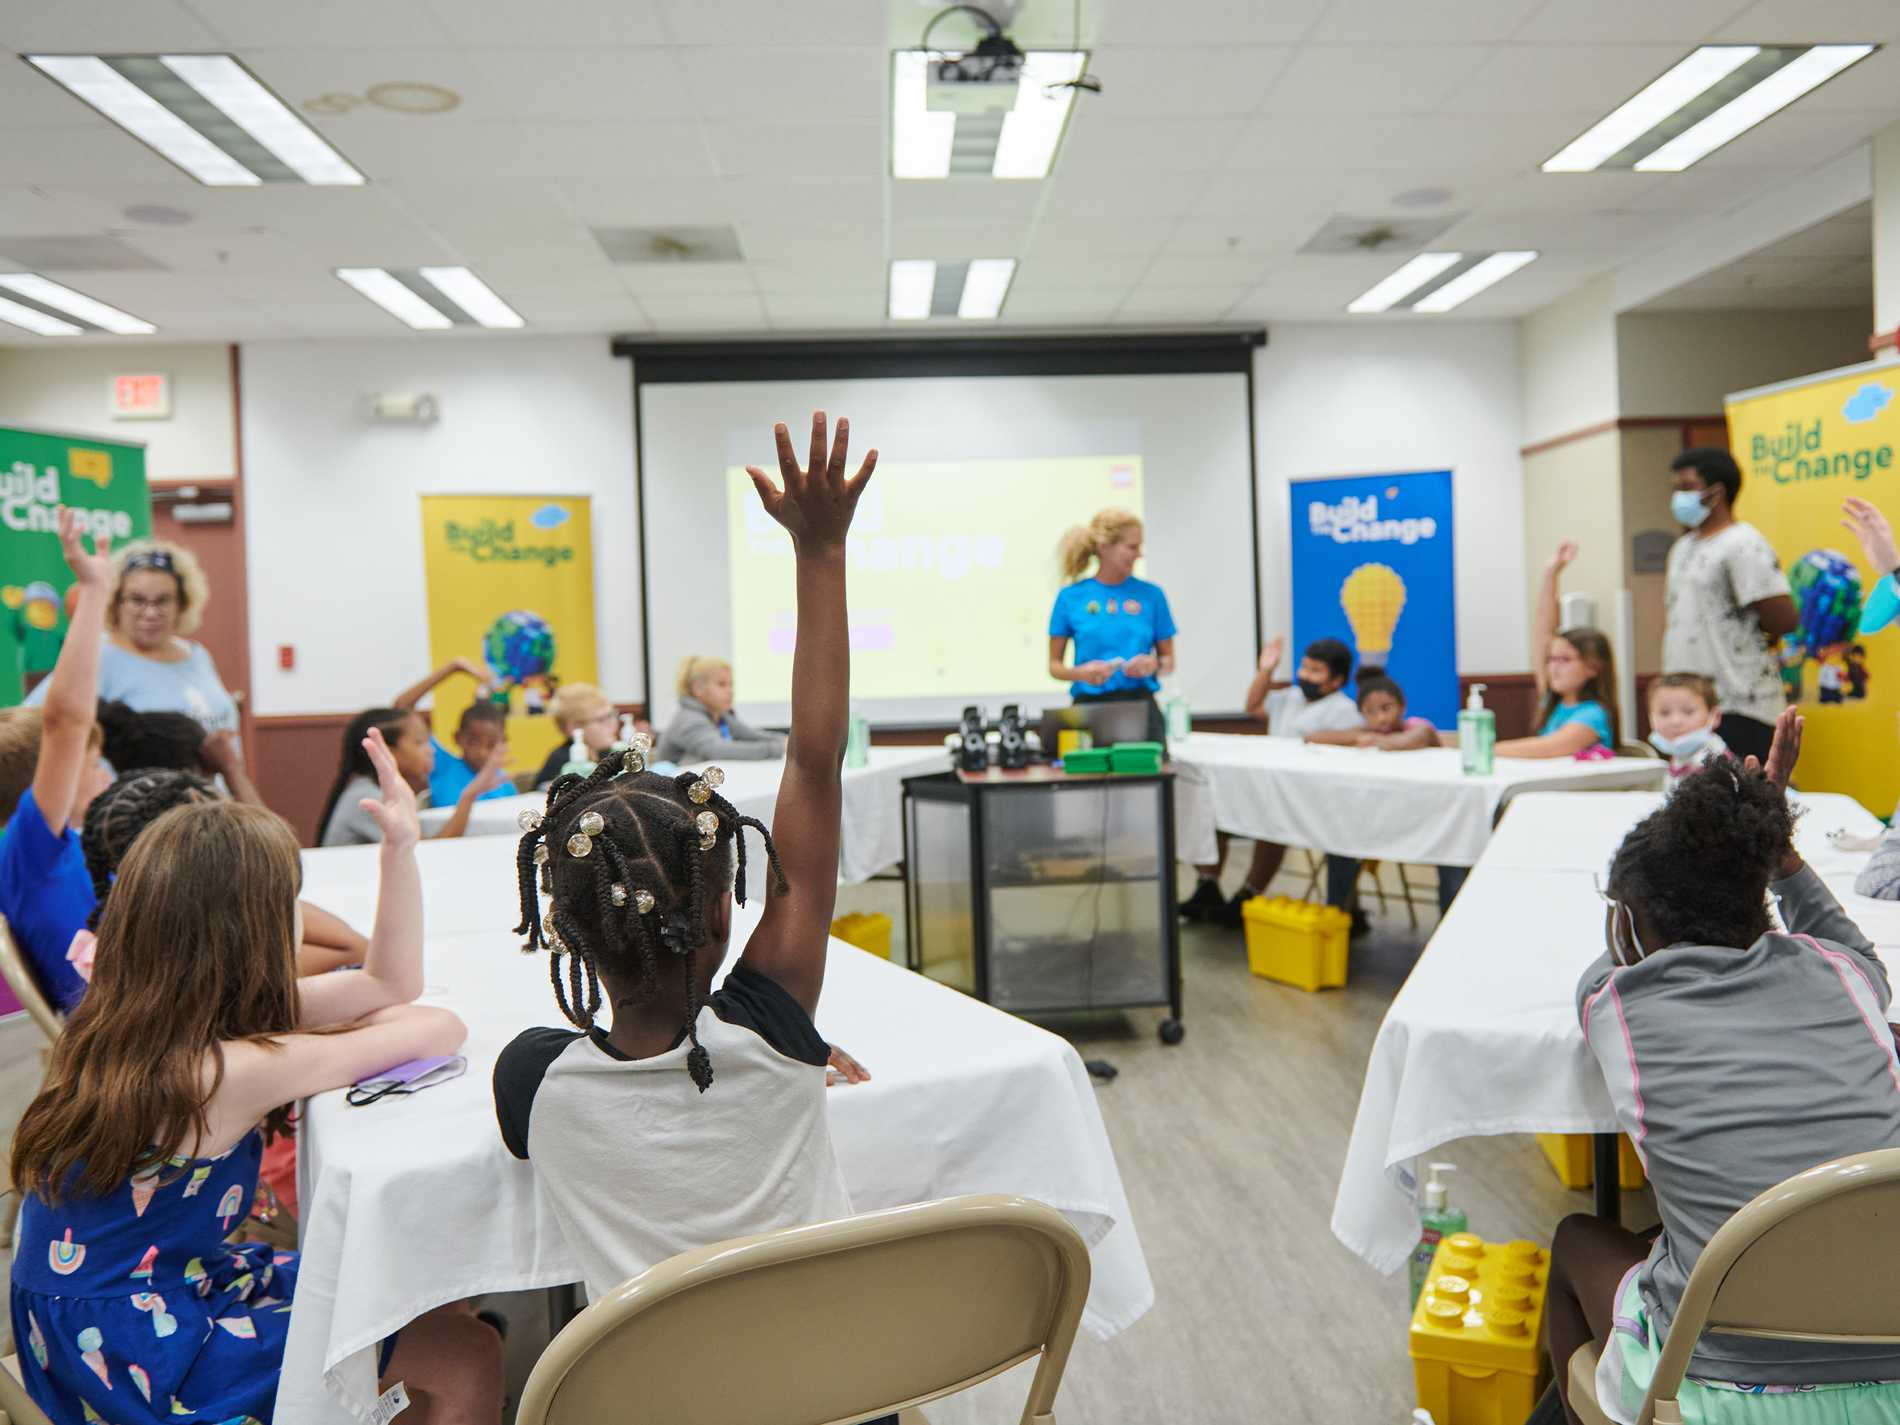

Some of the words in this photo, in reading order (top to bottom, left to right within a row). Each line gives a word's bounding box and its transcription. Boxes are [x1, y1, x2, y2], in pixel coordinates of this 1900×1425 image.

[115, 376, 161, 410] EXIT
[1752, 420, 1822, 462] Build
[1774, 443, 1893, 484] Change
[0, 461, 60, 505] uild
[1309, 495, 1378, 527] Build
[446, 517, 514, 549] Build
[1331, 516, 1437, 545] Change
[470, 543, 575, 568] Change
